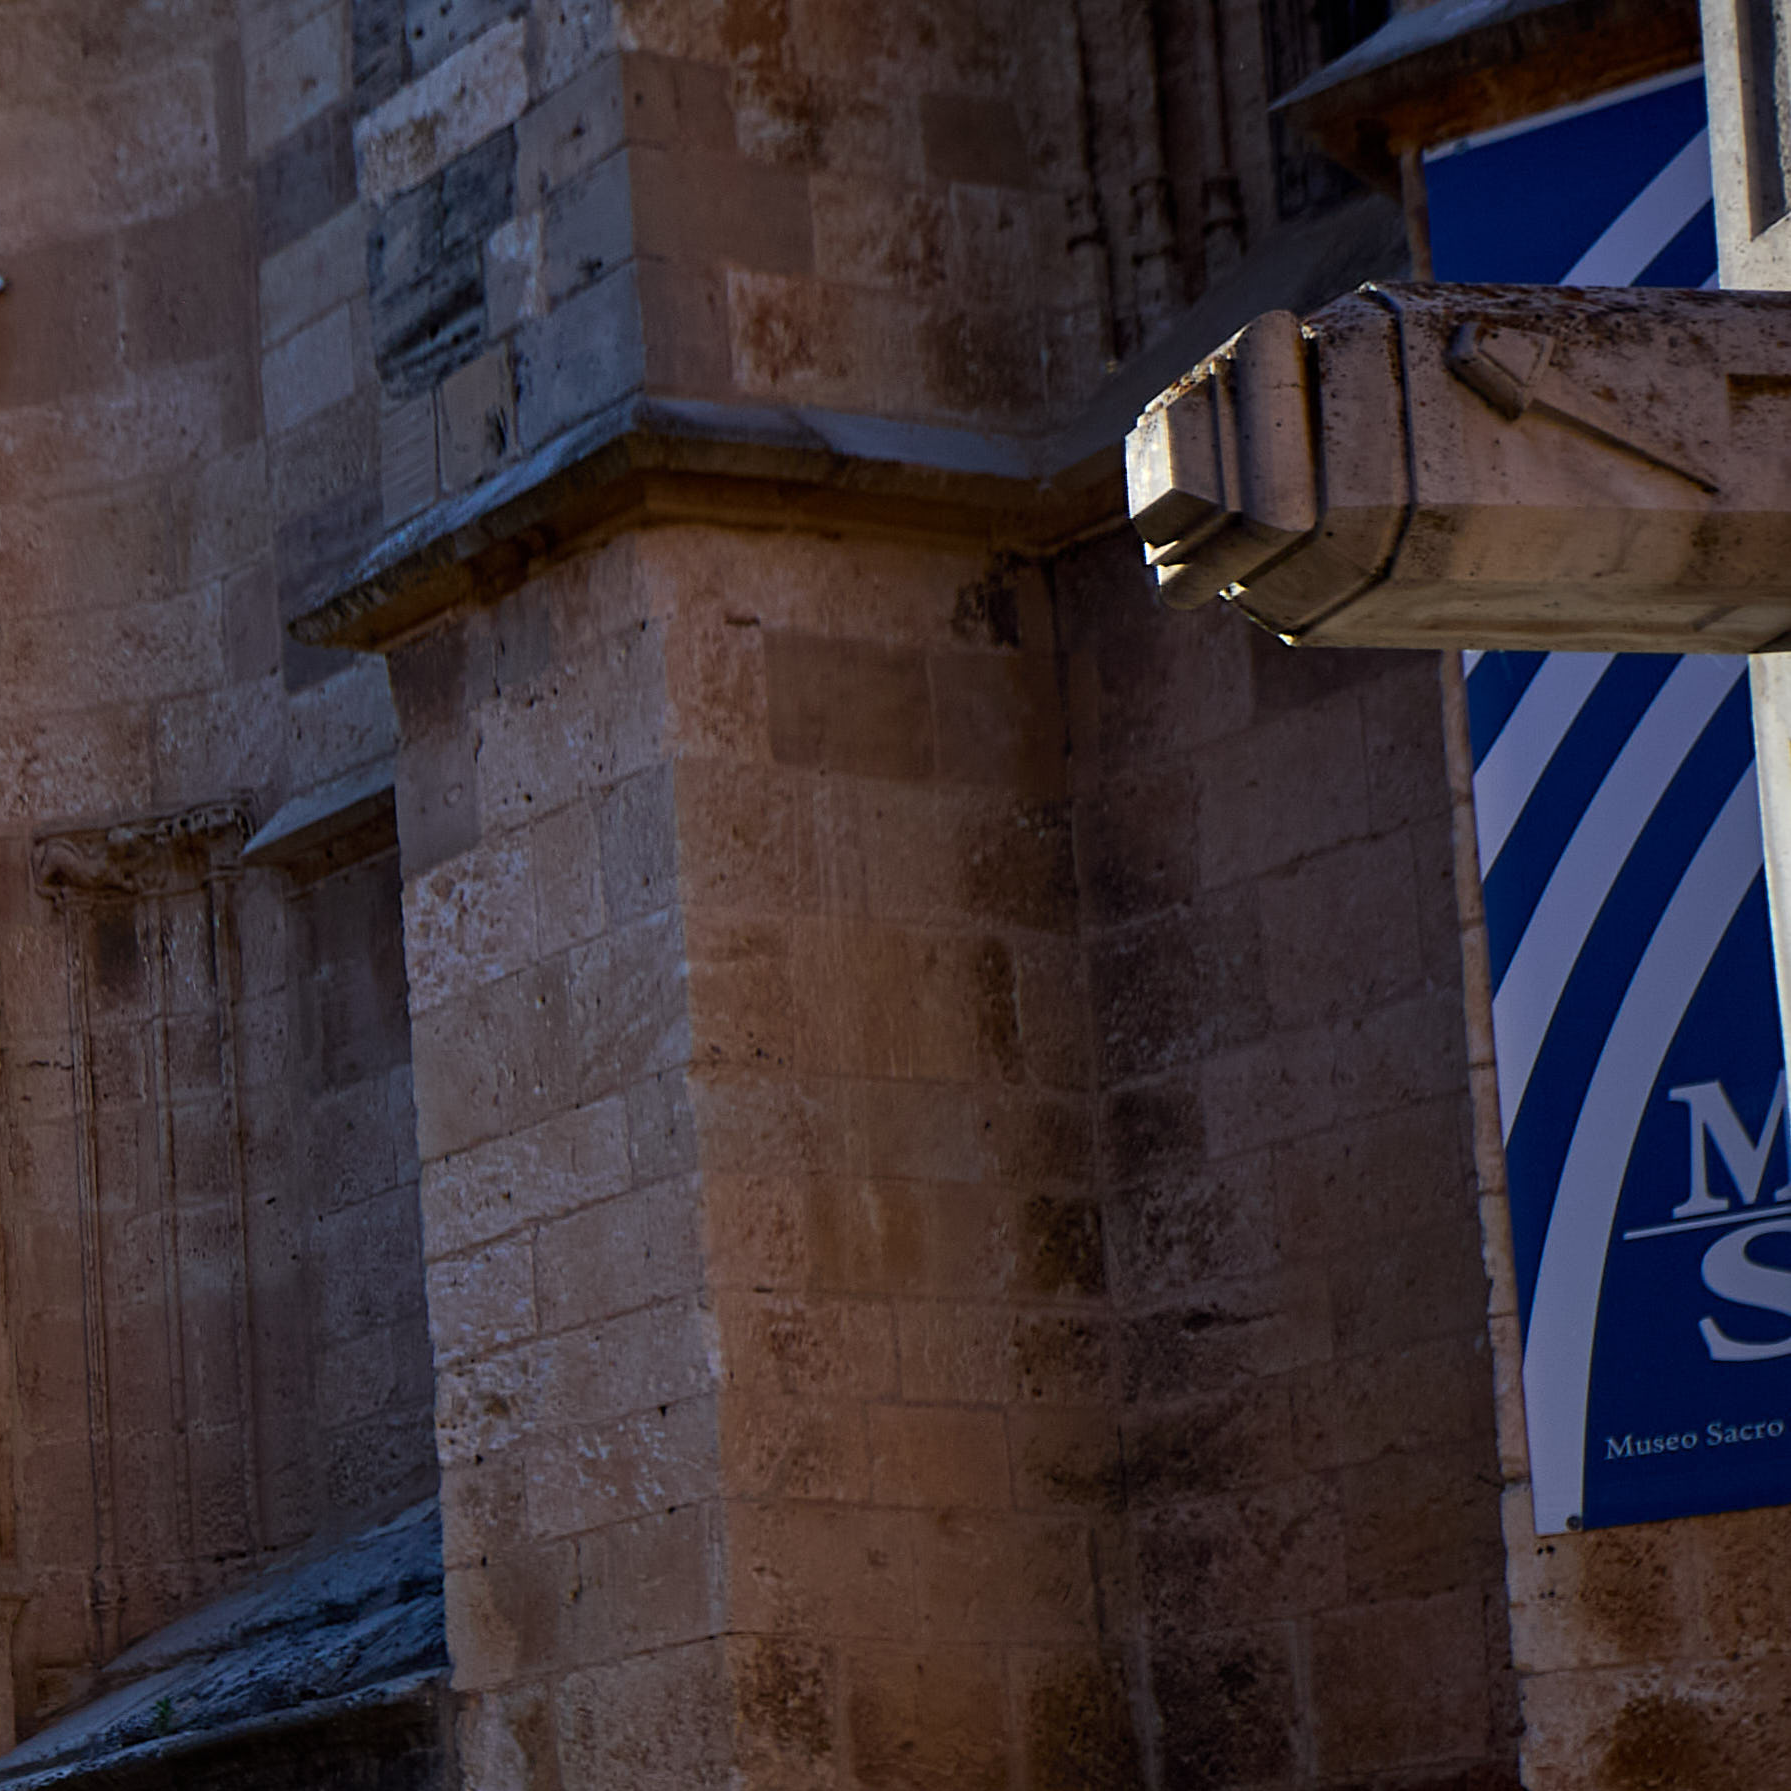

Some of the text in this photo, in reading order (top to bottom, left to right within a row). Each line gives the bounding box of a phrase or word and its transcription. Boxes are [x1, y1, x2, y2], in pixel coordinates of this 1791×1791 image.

[1668, 1068, 1790, 1219] M
[1604, 1419, 1784, 1460] Museo Sacro
